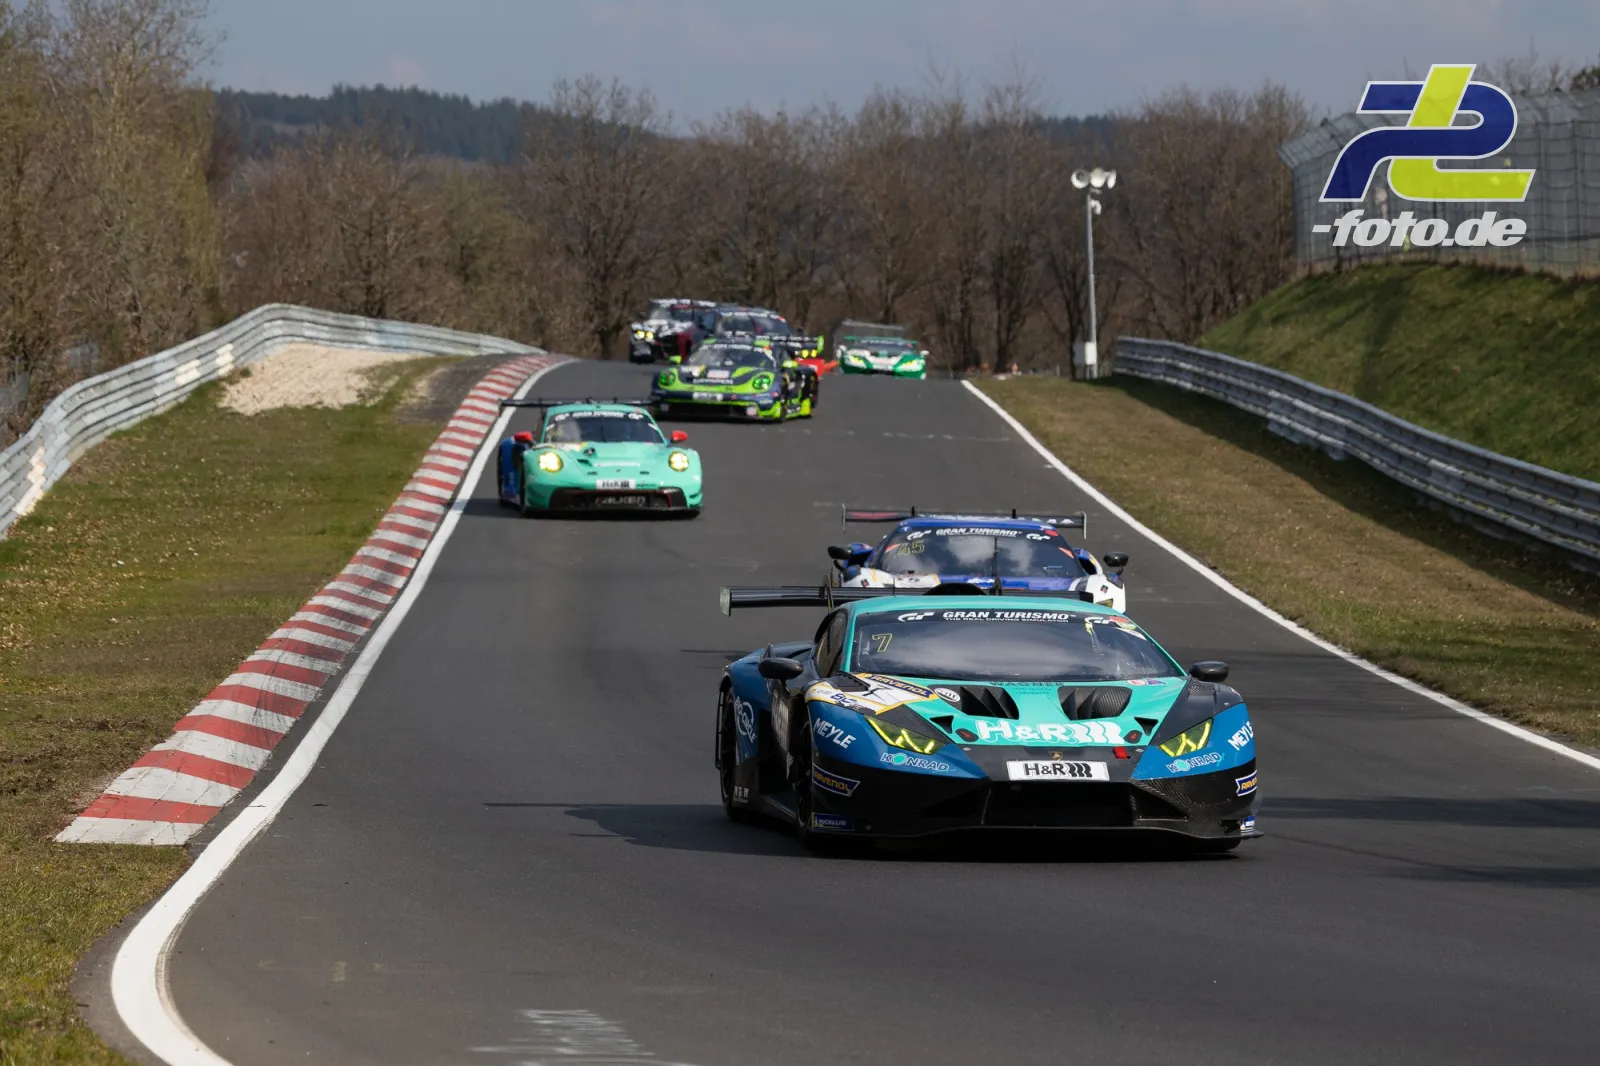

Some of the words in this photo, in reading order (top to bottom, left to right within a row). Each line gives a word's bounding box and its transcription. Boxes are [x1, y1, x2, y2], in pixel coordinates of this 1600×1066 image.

[969, 528, 1019, 536] TURISMO
[942, 611, 990, 619] GRAN
[994, 611, 1069, 620] TURISMO
[872, 633, 893, 652] 7
[870, 674, 929, 697] RAVENOL
[813, 717, 857, 749] MEYLE
[880, 752, 950, 771] KONRAD
[1166, 752, 1222, 773] KONRAD
